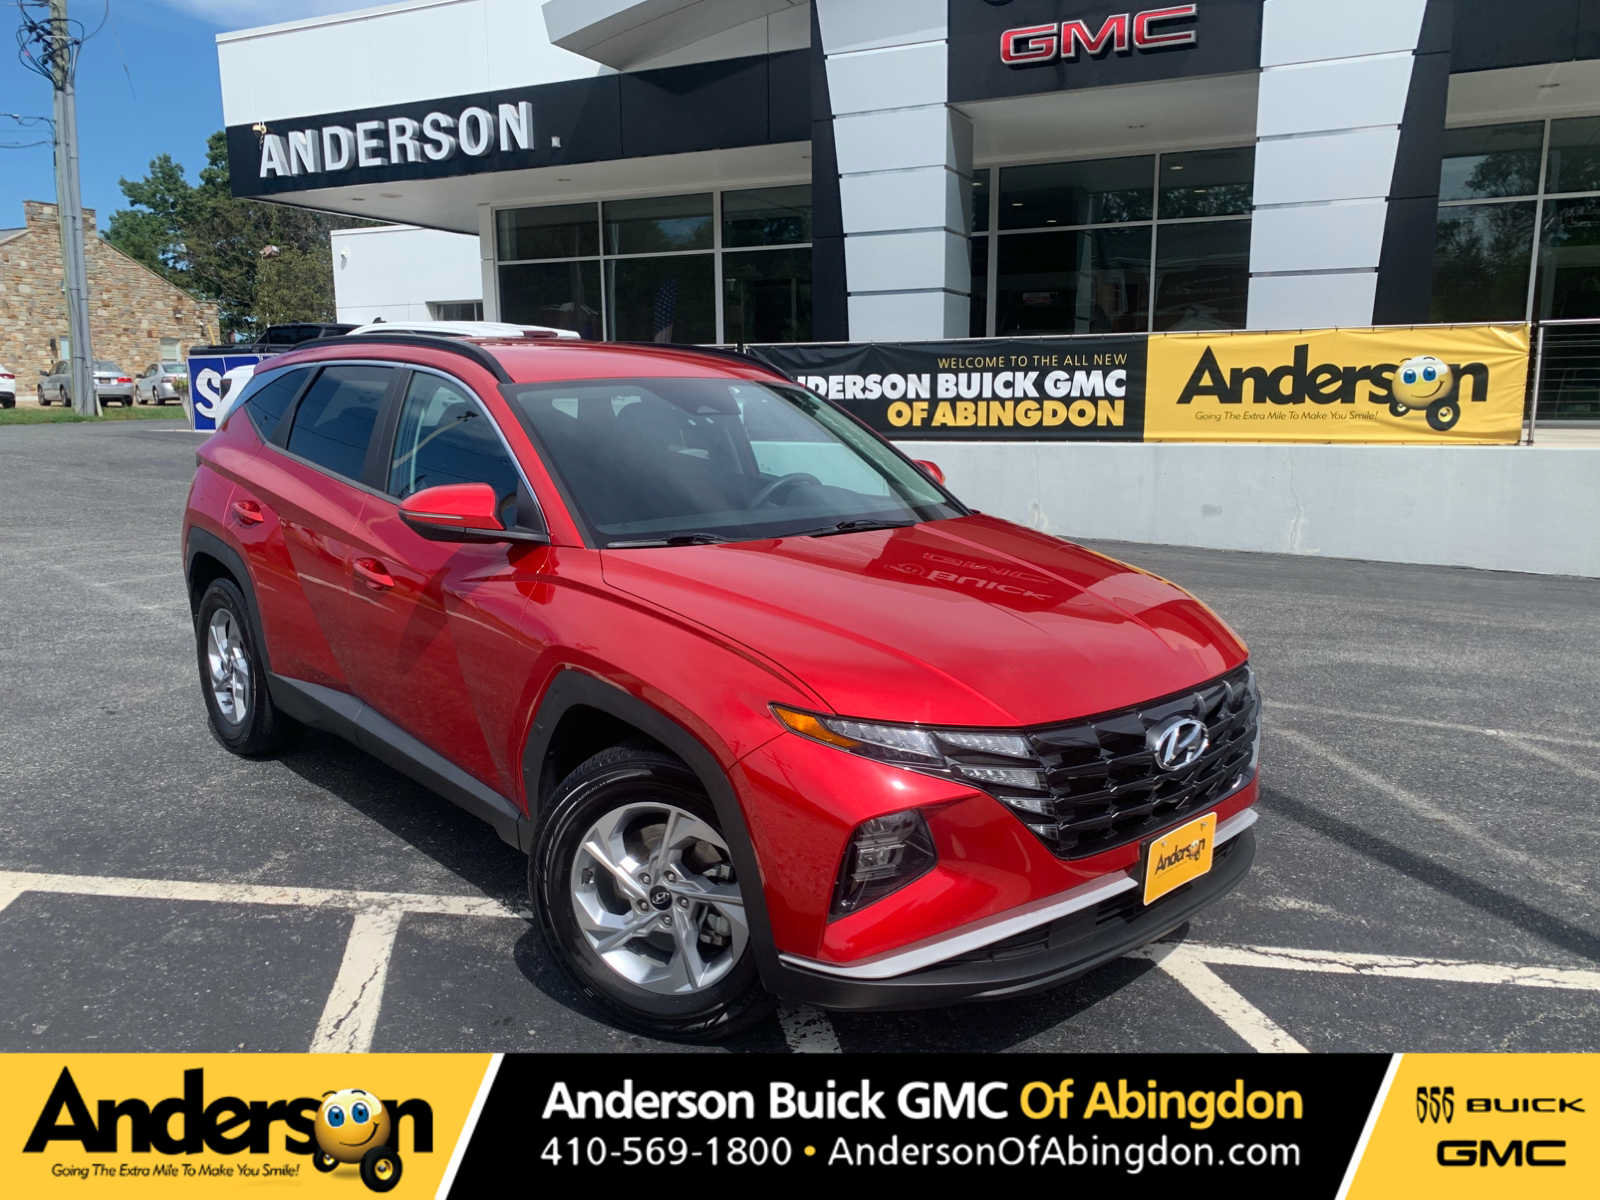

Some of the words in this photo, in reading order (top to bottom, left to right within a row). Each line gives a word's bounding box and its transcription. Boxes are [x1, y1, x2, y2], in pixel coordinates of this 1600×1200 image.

[1001, 3, 1197, 65] GMC
[259, 101, 534, 179] ANDERSON
[937, 356, 1005, 369] WELCOME
[1010, 356, 1029, 367] TO
[1032, 355, 1059, 367] THE
[1064, 354, 1089, 367] ALL
[1094, 353, 1128, 366] NEW
[797, 373, 931, 400] DERSON
[937, 371, 1039, 399] BUICK
[1044, 369, 1126, 398] GMC
[887, 401, 929, 427] OF
[931, 400, 1124, 427] ABINGDON
[1195, 411, 1221, 422] Going
[1224, 411, 1241, 420] The
[1243, 412, 1265, 420] Extra
[1266, 411, 1286, 420] Mile
[1289, 411, 1299, 420] To
[1300, 411, 1327, 420] Make
[1331, 411, 1347, 420] You
[1349, 411, 1379, 421] Smile!
